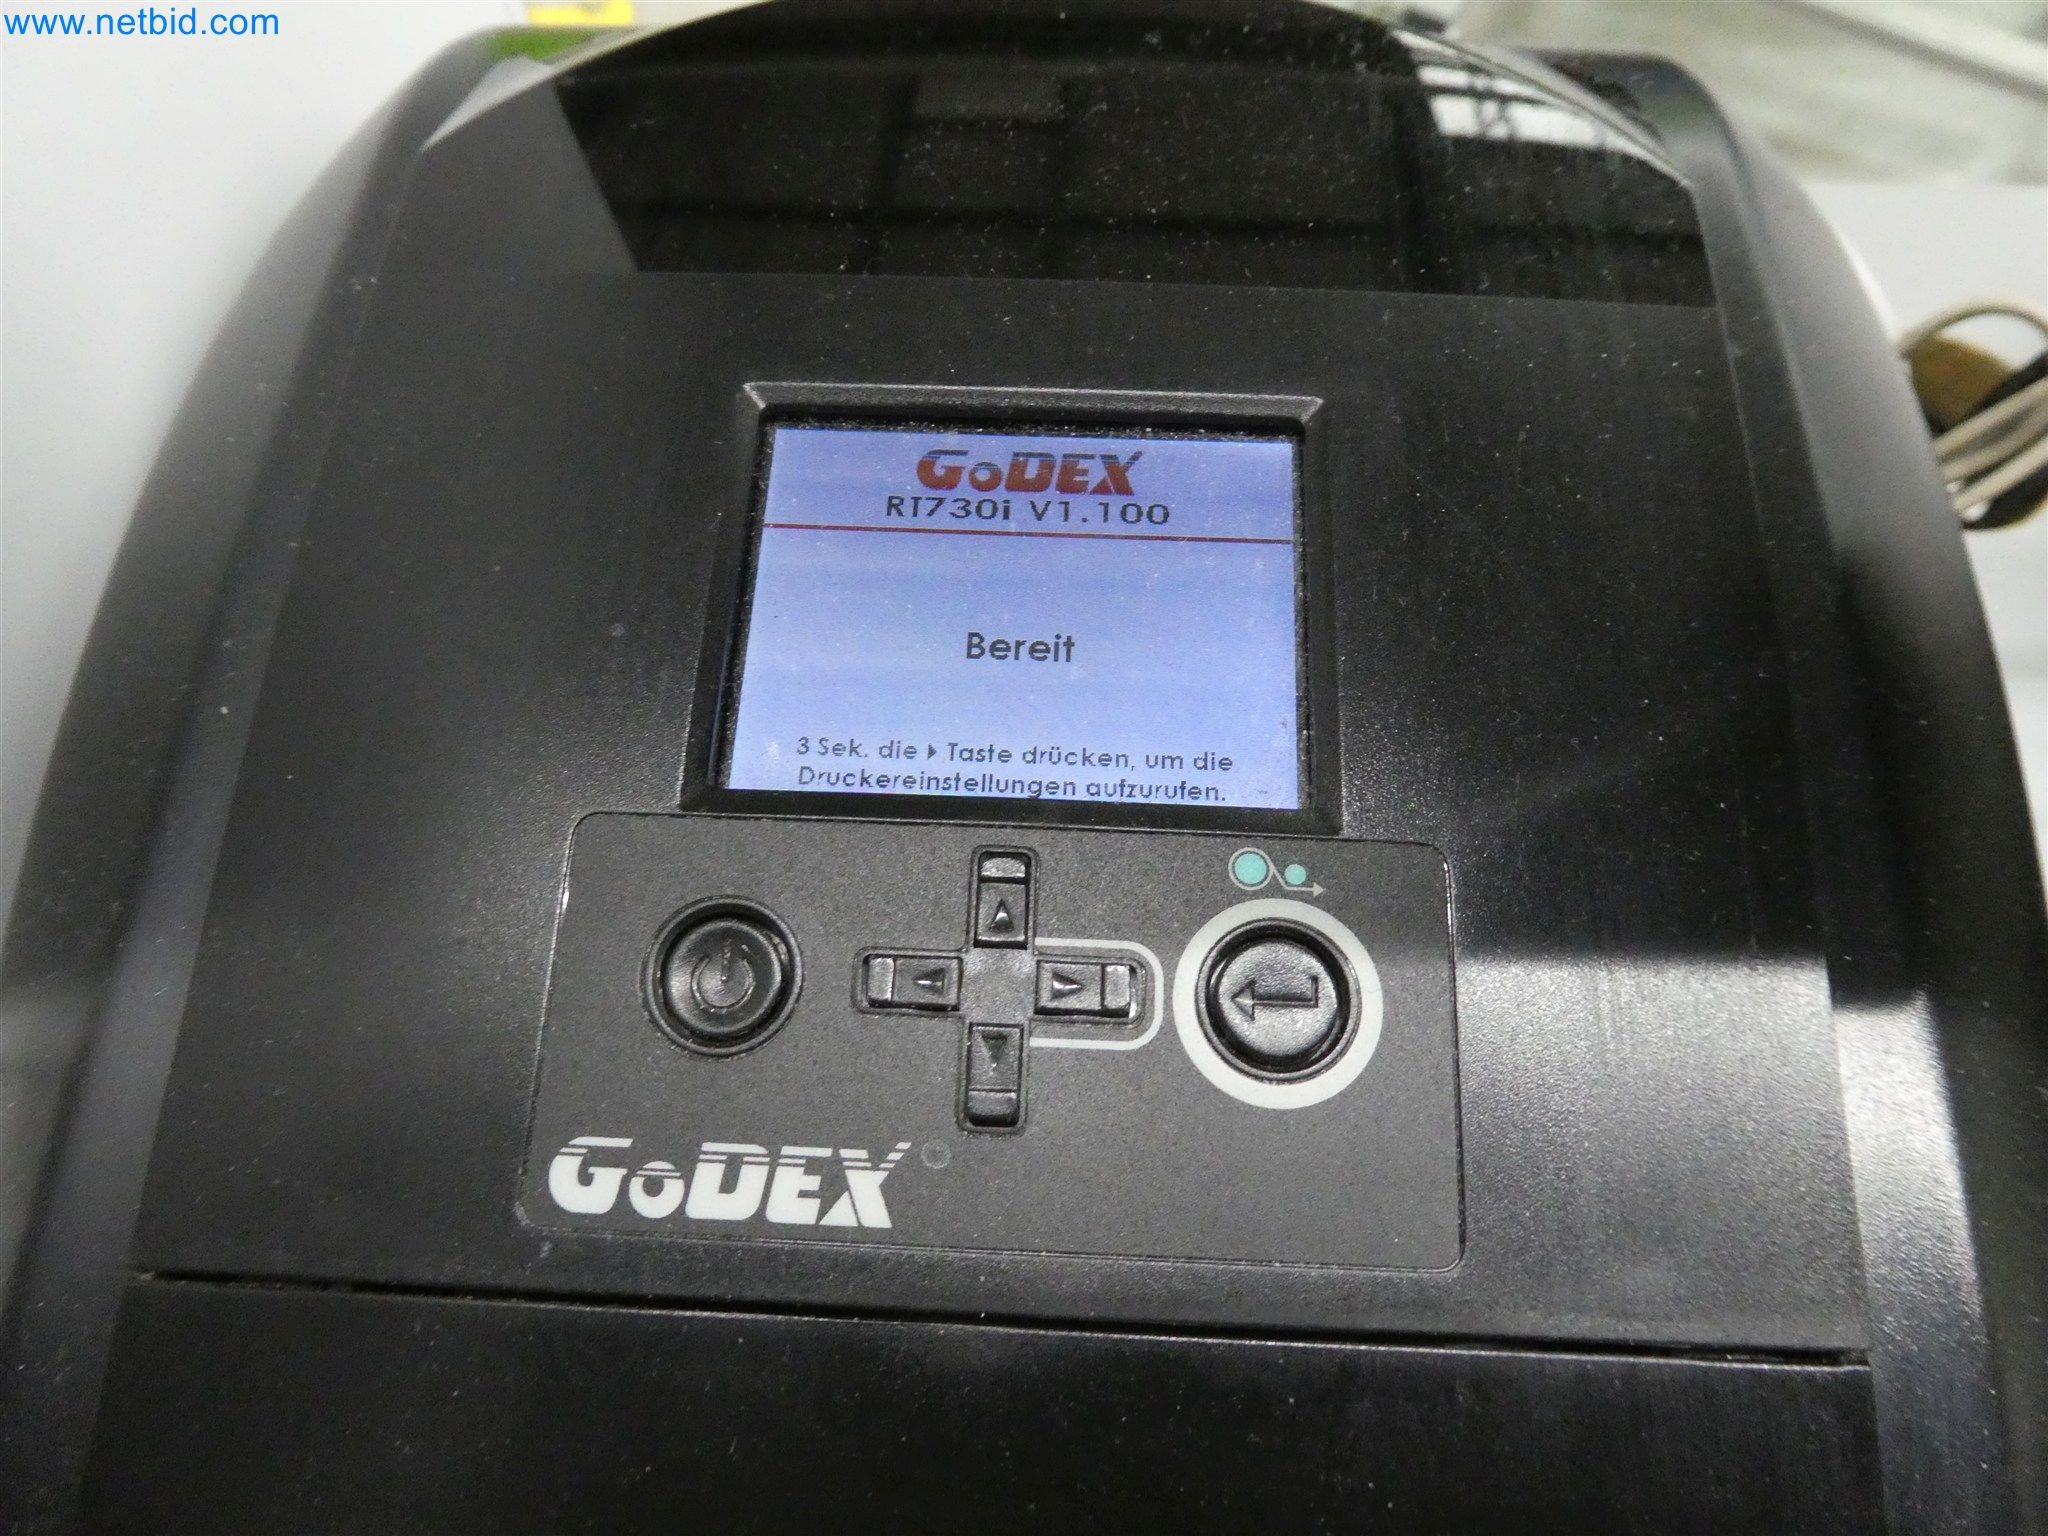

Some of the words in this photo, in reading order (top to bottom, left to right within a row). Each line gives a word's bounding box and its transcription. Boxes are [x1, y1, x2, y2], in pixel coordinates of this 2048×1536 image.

[916, 448, 1143, 496] GoDEX
[885, 495, 1011, 521] RT730i
[1029, 500, 1170, 525] V1.100
[966, 631, 1075, 663] Bereit
[797, 736, 810, 756] 3
[817, 737, 868, 759] Sek.
[878, 739, 918, 760] die
[947, 742, 1013, 763] Taste
[1022, 746, 1135, 772] drücken,
[1145, 753, 1184, 770] um
[1193, 752, 1233, 772] die
[799, 766, 1076, 799] Druckereinstellungen
[1086, 778, 1226, 801] aufzurufen.
[548, 1136, 912, 1229] GoDEX
